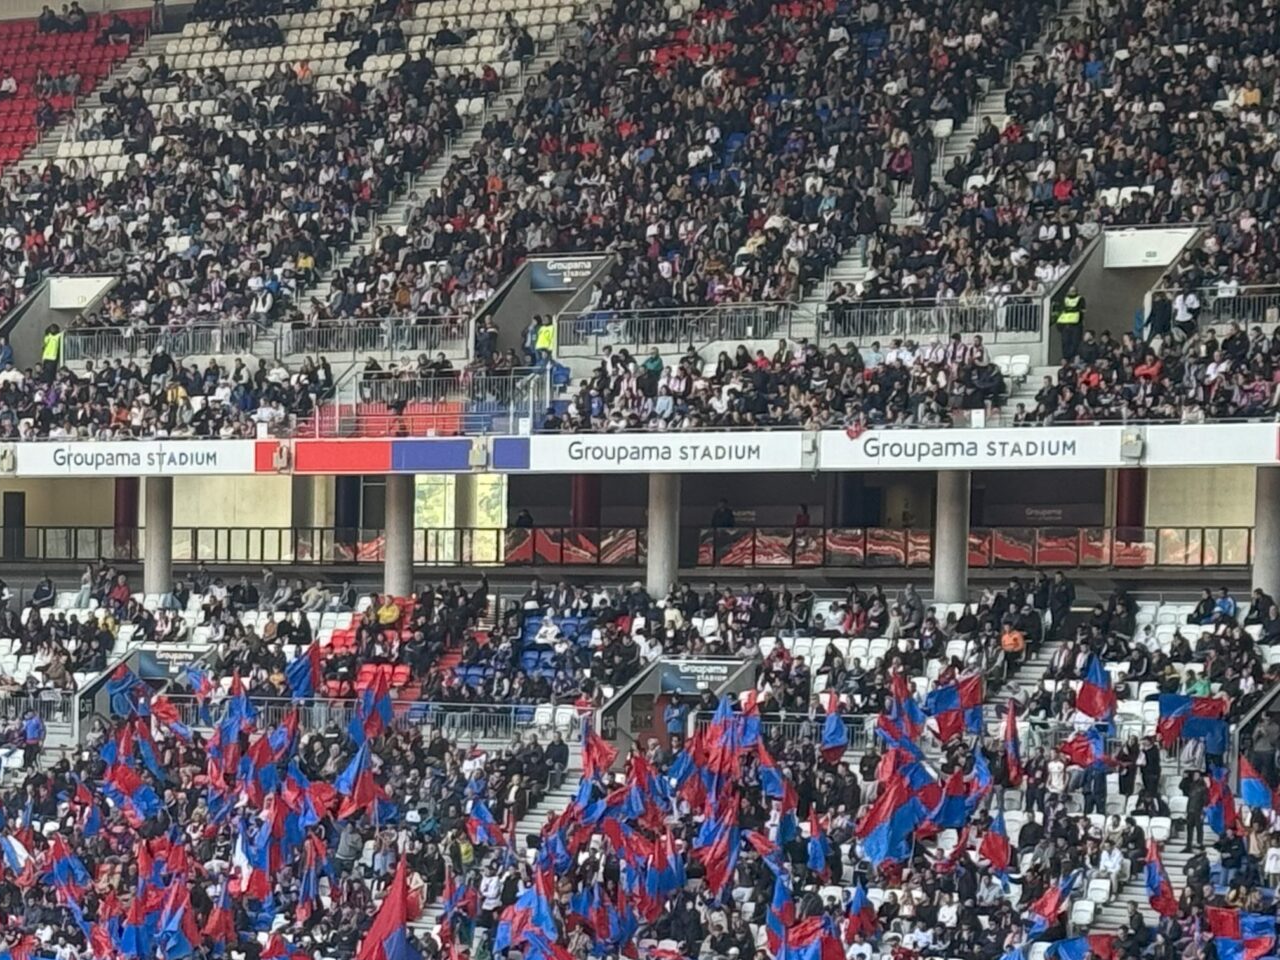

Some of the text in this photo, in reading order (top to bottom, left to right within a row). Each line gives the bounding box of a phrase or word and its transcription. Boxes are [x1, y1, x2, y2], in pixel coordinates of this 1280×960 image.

[53, 448, 217, 470] Groupama STADIUM
[568, 440, 761, 464] Groupama STADIUM
[863, 437, 1077, 462] Groupama STADIUM
